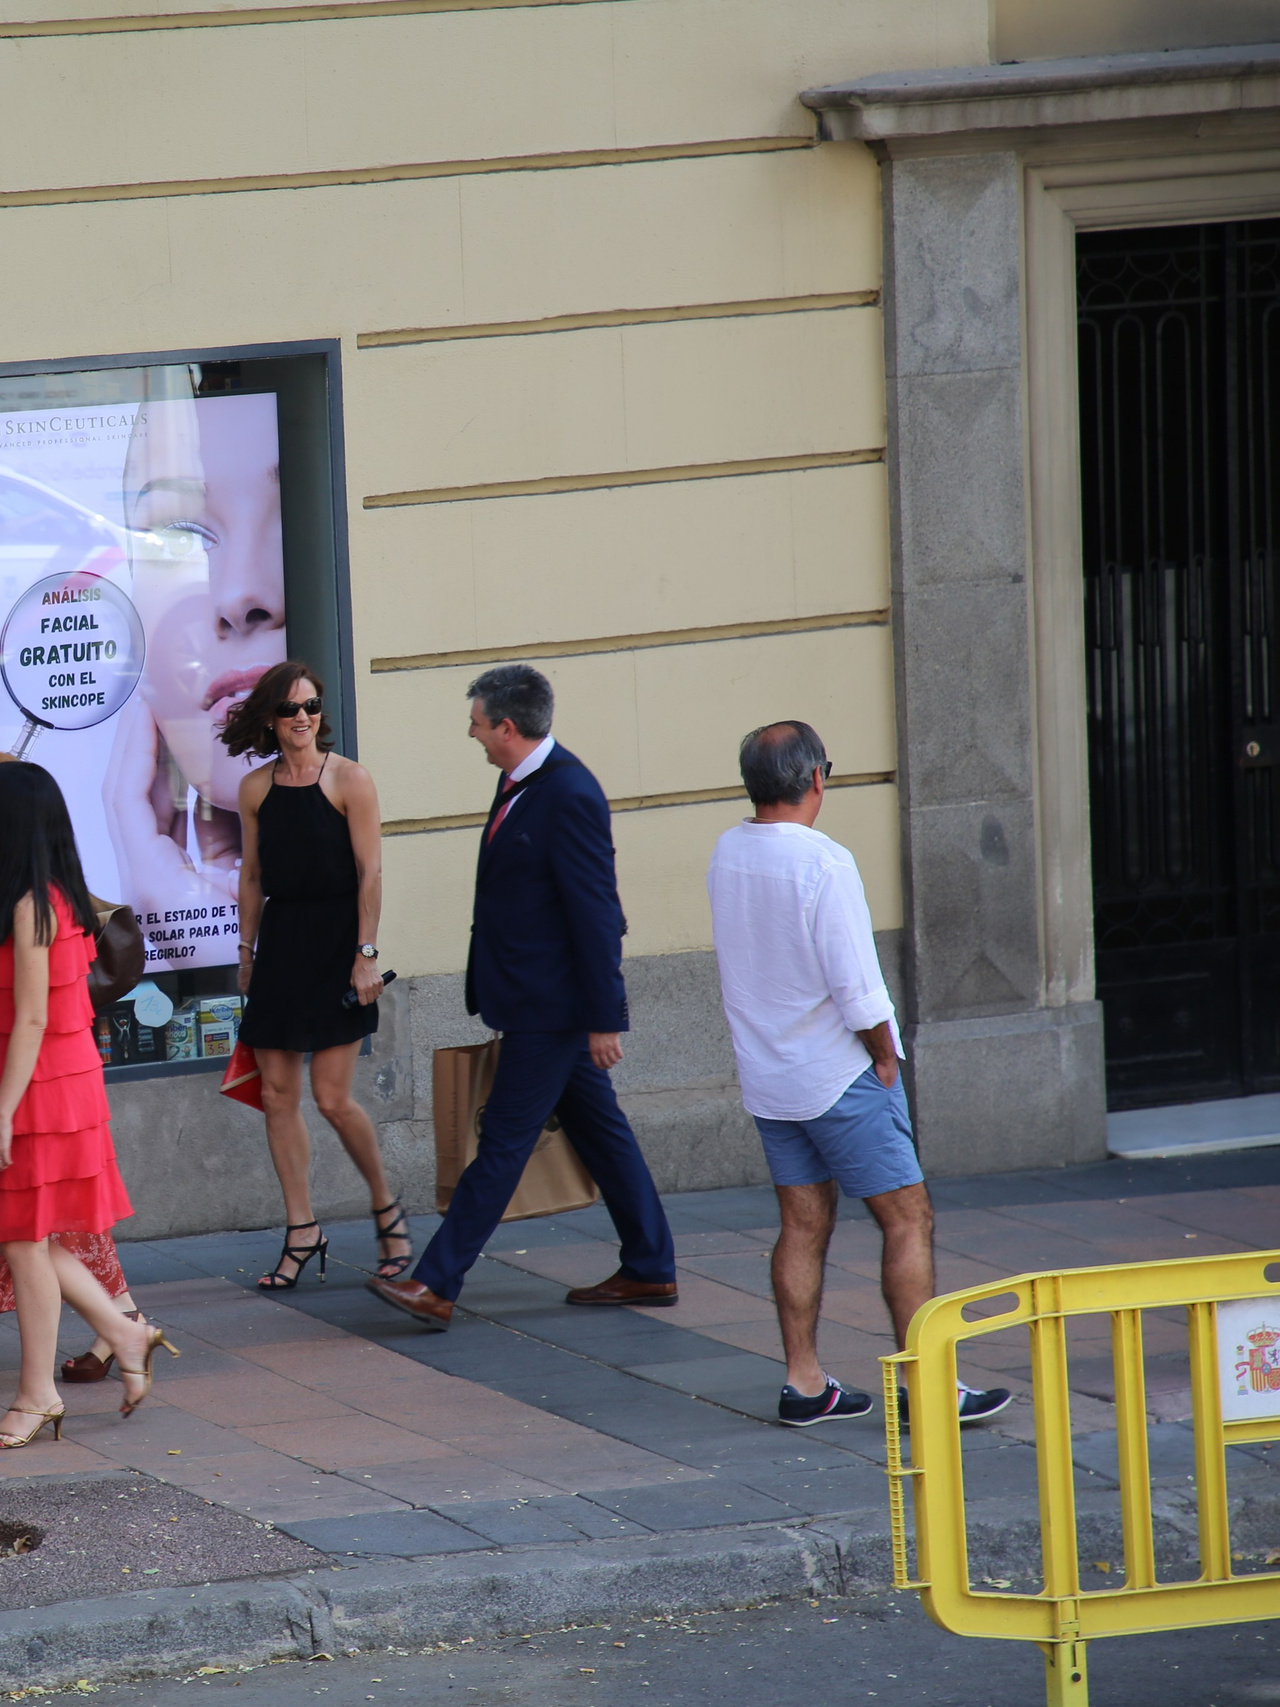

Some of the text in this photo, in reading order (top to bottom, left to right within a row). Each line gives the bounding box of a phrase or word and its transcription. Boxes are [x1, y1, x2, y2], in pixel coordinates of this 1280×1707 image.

[37, 435, 101, 446] PROFESSIONAL
[41, 586, 101, 606] ANÁLISIS
[40, 614, 99, 634] FACIAL
[20, 639, 117, 667] GRATUITO
[48, 671, 96, 688] CON EL
[41, 692, 105, 710] SKINCOPE
[146, 912, 161, 925] EL
[164, 908, 208, 922] ESTADO
[211, 906, 226, 918] DE
[148, 922, 240, 943] SOLAR PARA PO
[144, 945, 196, 961] REGIRLO?
